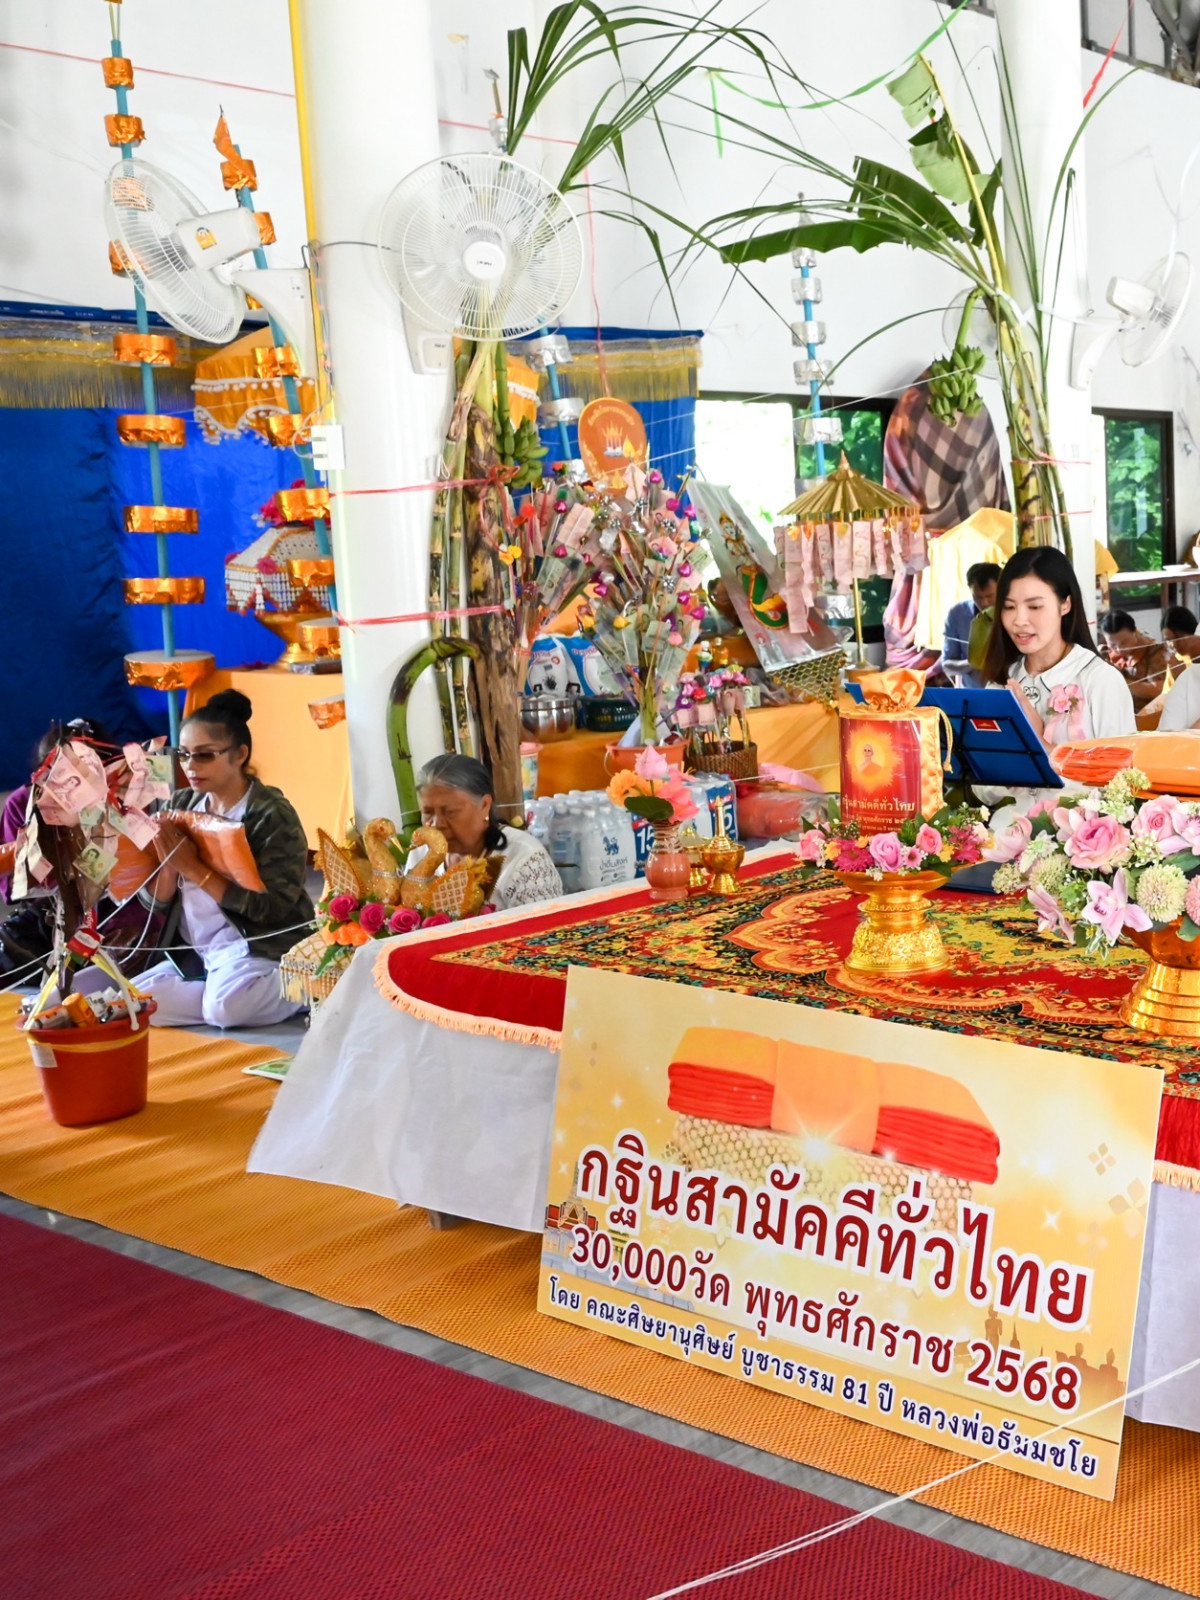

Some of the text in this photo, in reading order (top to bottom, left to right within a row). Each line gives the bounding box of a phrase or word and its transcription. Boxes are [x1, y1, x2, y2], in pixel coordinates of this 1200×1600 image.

[580, 1133, 1088, 1324] กฐินสามัคคีทั่วไทย
[548, 1276, 580, 1310] โดย
[587, 1296, 736, 1361] คณะศิษยานุศิษย์
[741, 1347, 834, 1393] บูชาธรรม
[843, 1378, 868, 1405] 81
[878, 1381, 893, 1413] ปี
[744, 1281, 954, 1374] พุทธศักราช
[967, 1342, 1080, 1411] 2568
